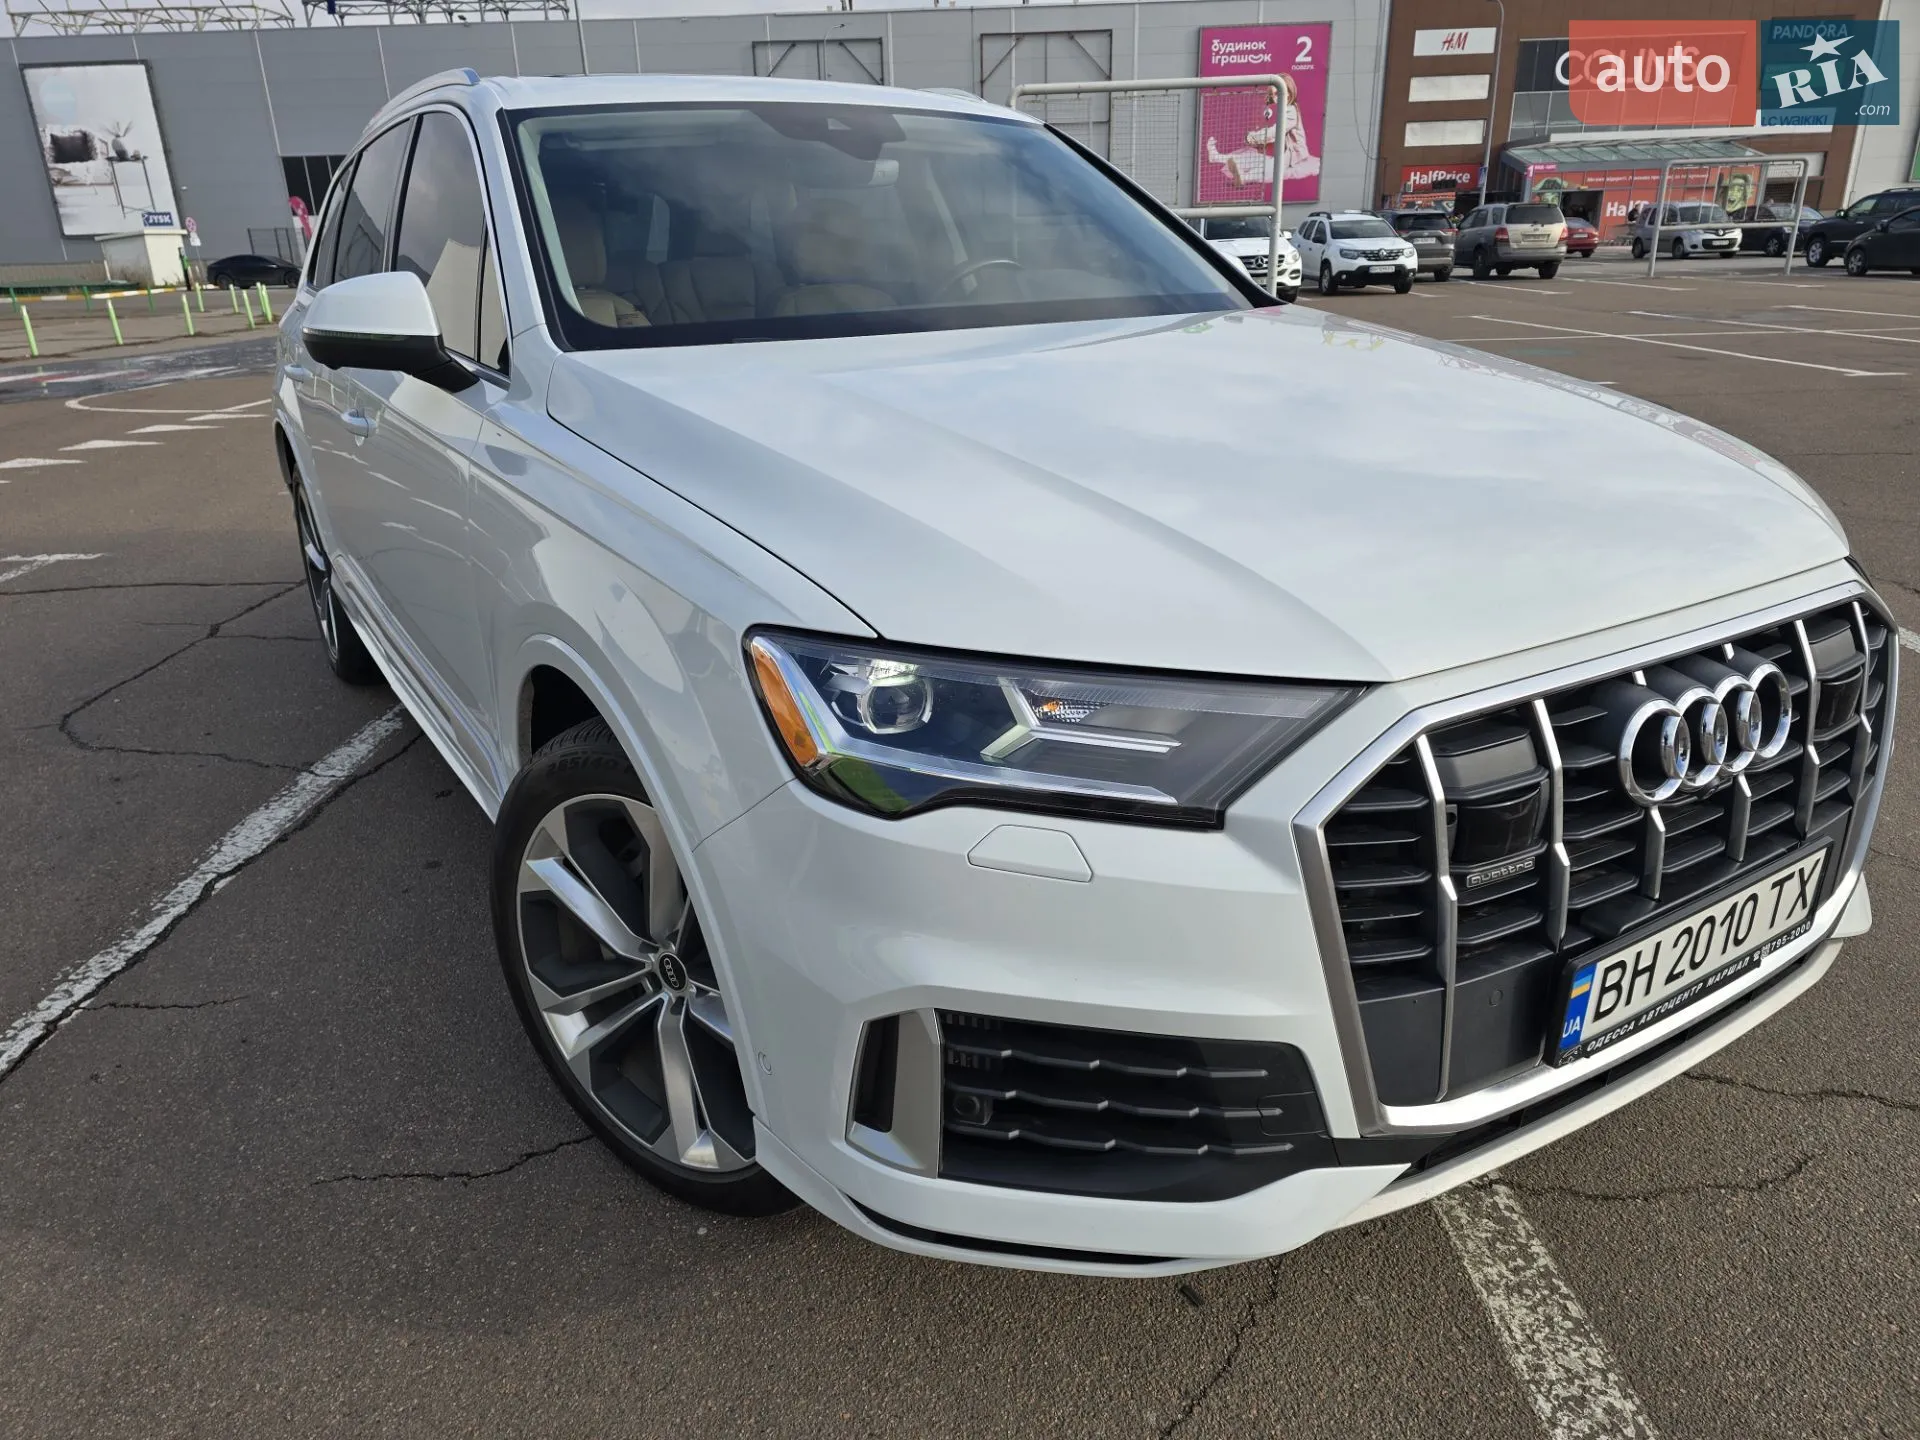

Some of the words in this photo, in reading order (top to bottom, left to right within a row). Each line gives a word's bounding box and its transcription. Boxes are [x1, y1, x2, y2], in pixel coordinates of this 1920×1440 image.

[1211, 39, 1266, 53] будинок
[1295, 36, 1312, 62] 2
[1410, 170, 1471, 185] HalfPrice
[148, 214, 172, 224] JYSK
[1471, 860, 1533, 884] quattro
[1592, 940, 1662, 1023] BH
[1664, 893, 1759, 986] 2010
[1769, 857, 1821, 930] TX
[1587, 1023, 1635, 1052] ОДЕССА
[1639, 982, 1703, 1026] АВТОЦЕНТР
[1771, 921, 1811, 951] 795-2000
[1562, 1016, 1581, 1038] UA
